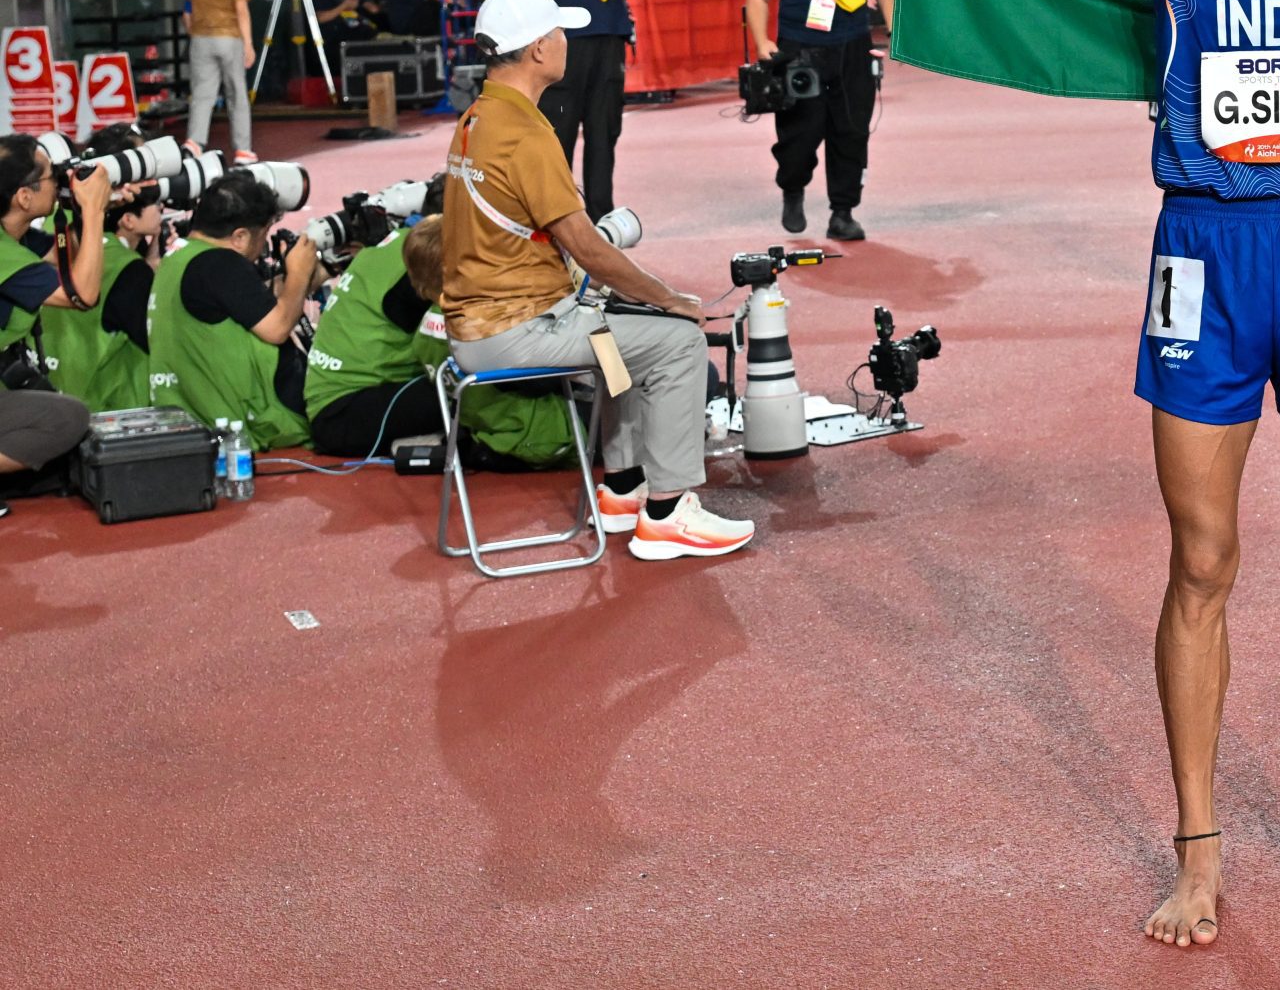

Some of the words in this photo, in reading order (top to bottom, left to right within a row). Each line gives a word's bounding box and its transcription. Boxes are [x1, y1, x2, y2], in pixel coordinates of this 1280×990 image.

[7, 36, 44, 83] 3
[1239, 75, 1273, 84] SPORTS
[91, 63, 126, 108] 2
[1161, 266, 1173, 328] 1
[1160, 343, 1195, 360] JSW
